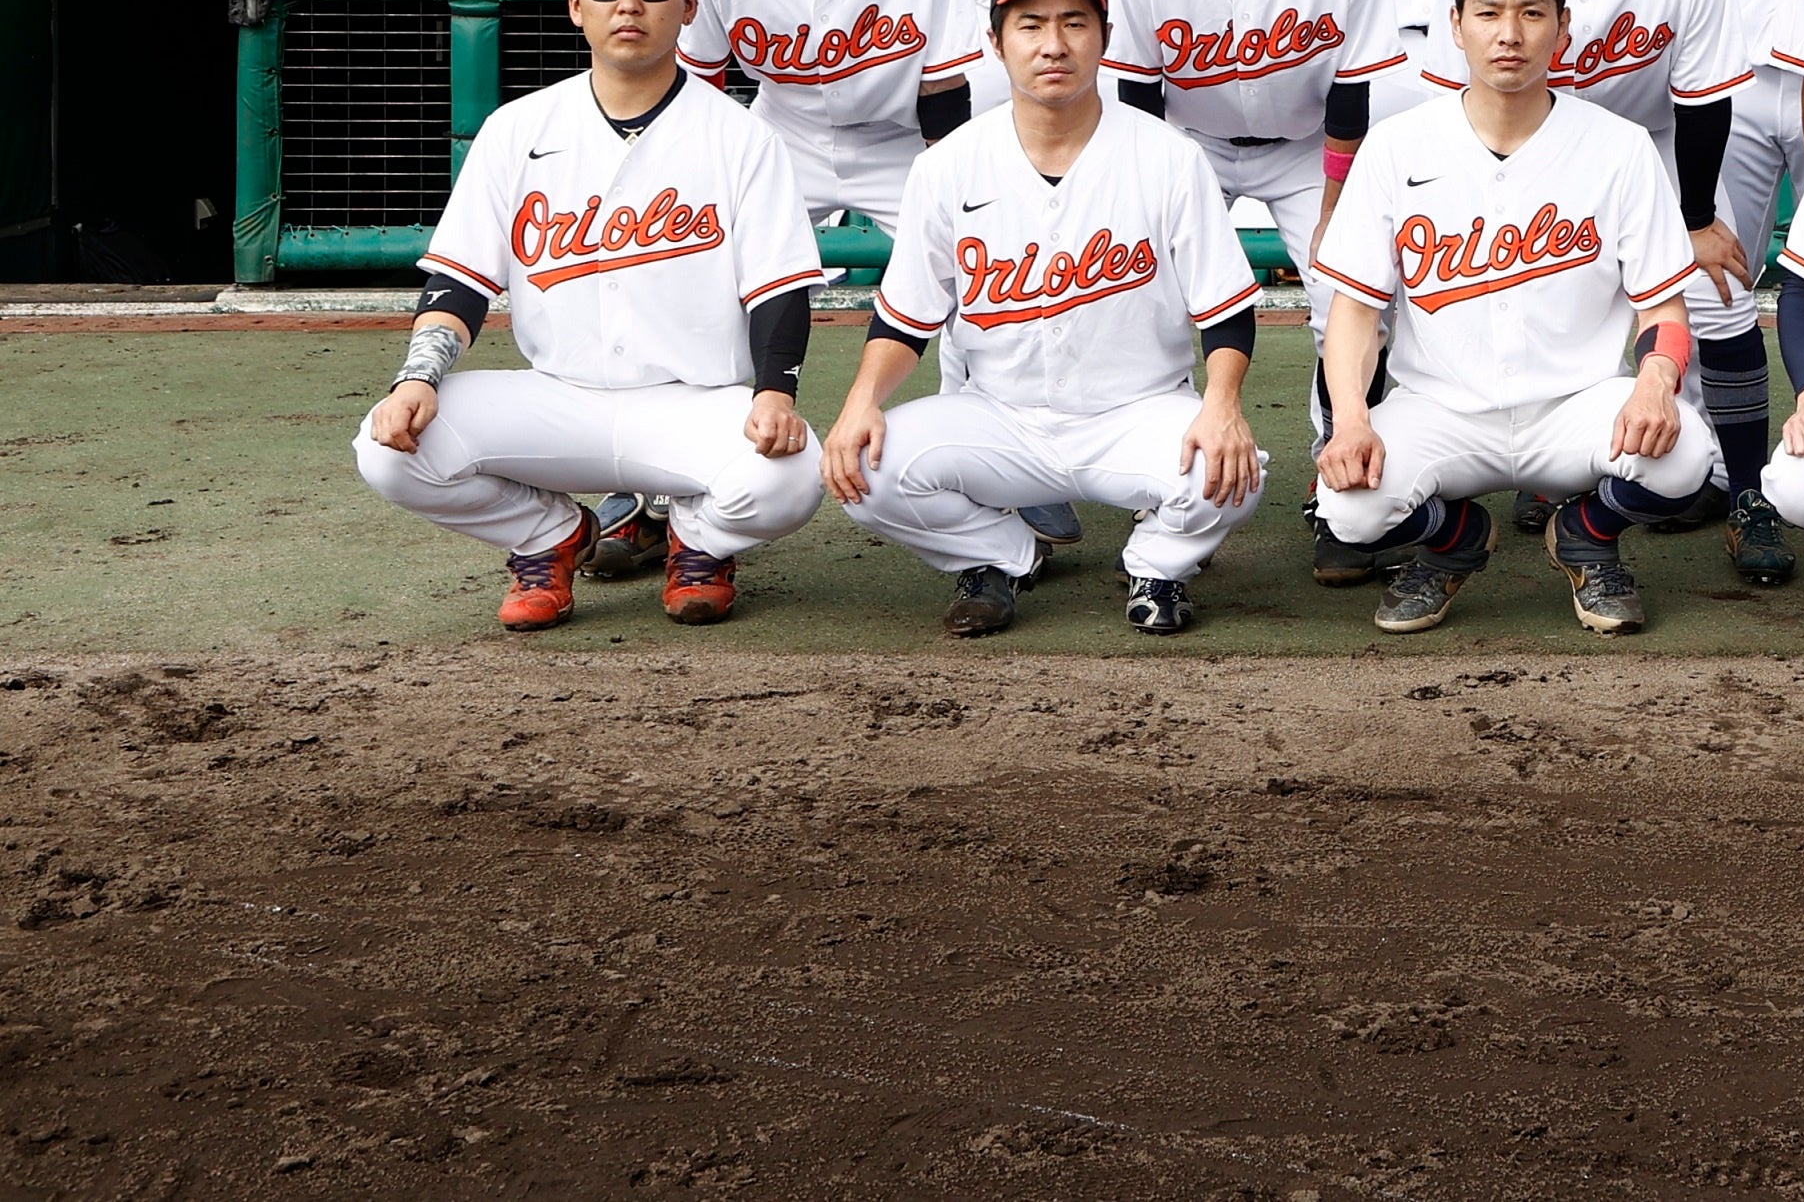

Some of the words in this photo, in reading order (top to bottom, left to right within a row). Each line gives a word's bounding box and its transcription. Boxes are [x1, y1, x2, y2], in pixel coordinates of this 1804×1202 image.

[728, 3, 927, 71] Orioles
[1155, 8, 1345, 74] Orioles
[510, 186, 725, 268] Orioles
[956, 227, 1158, 307] Orioles
[1394, 202, 1602, 290] Orioles
